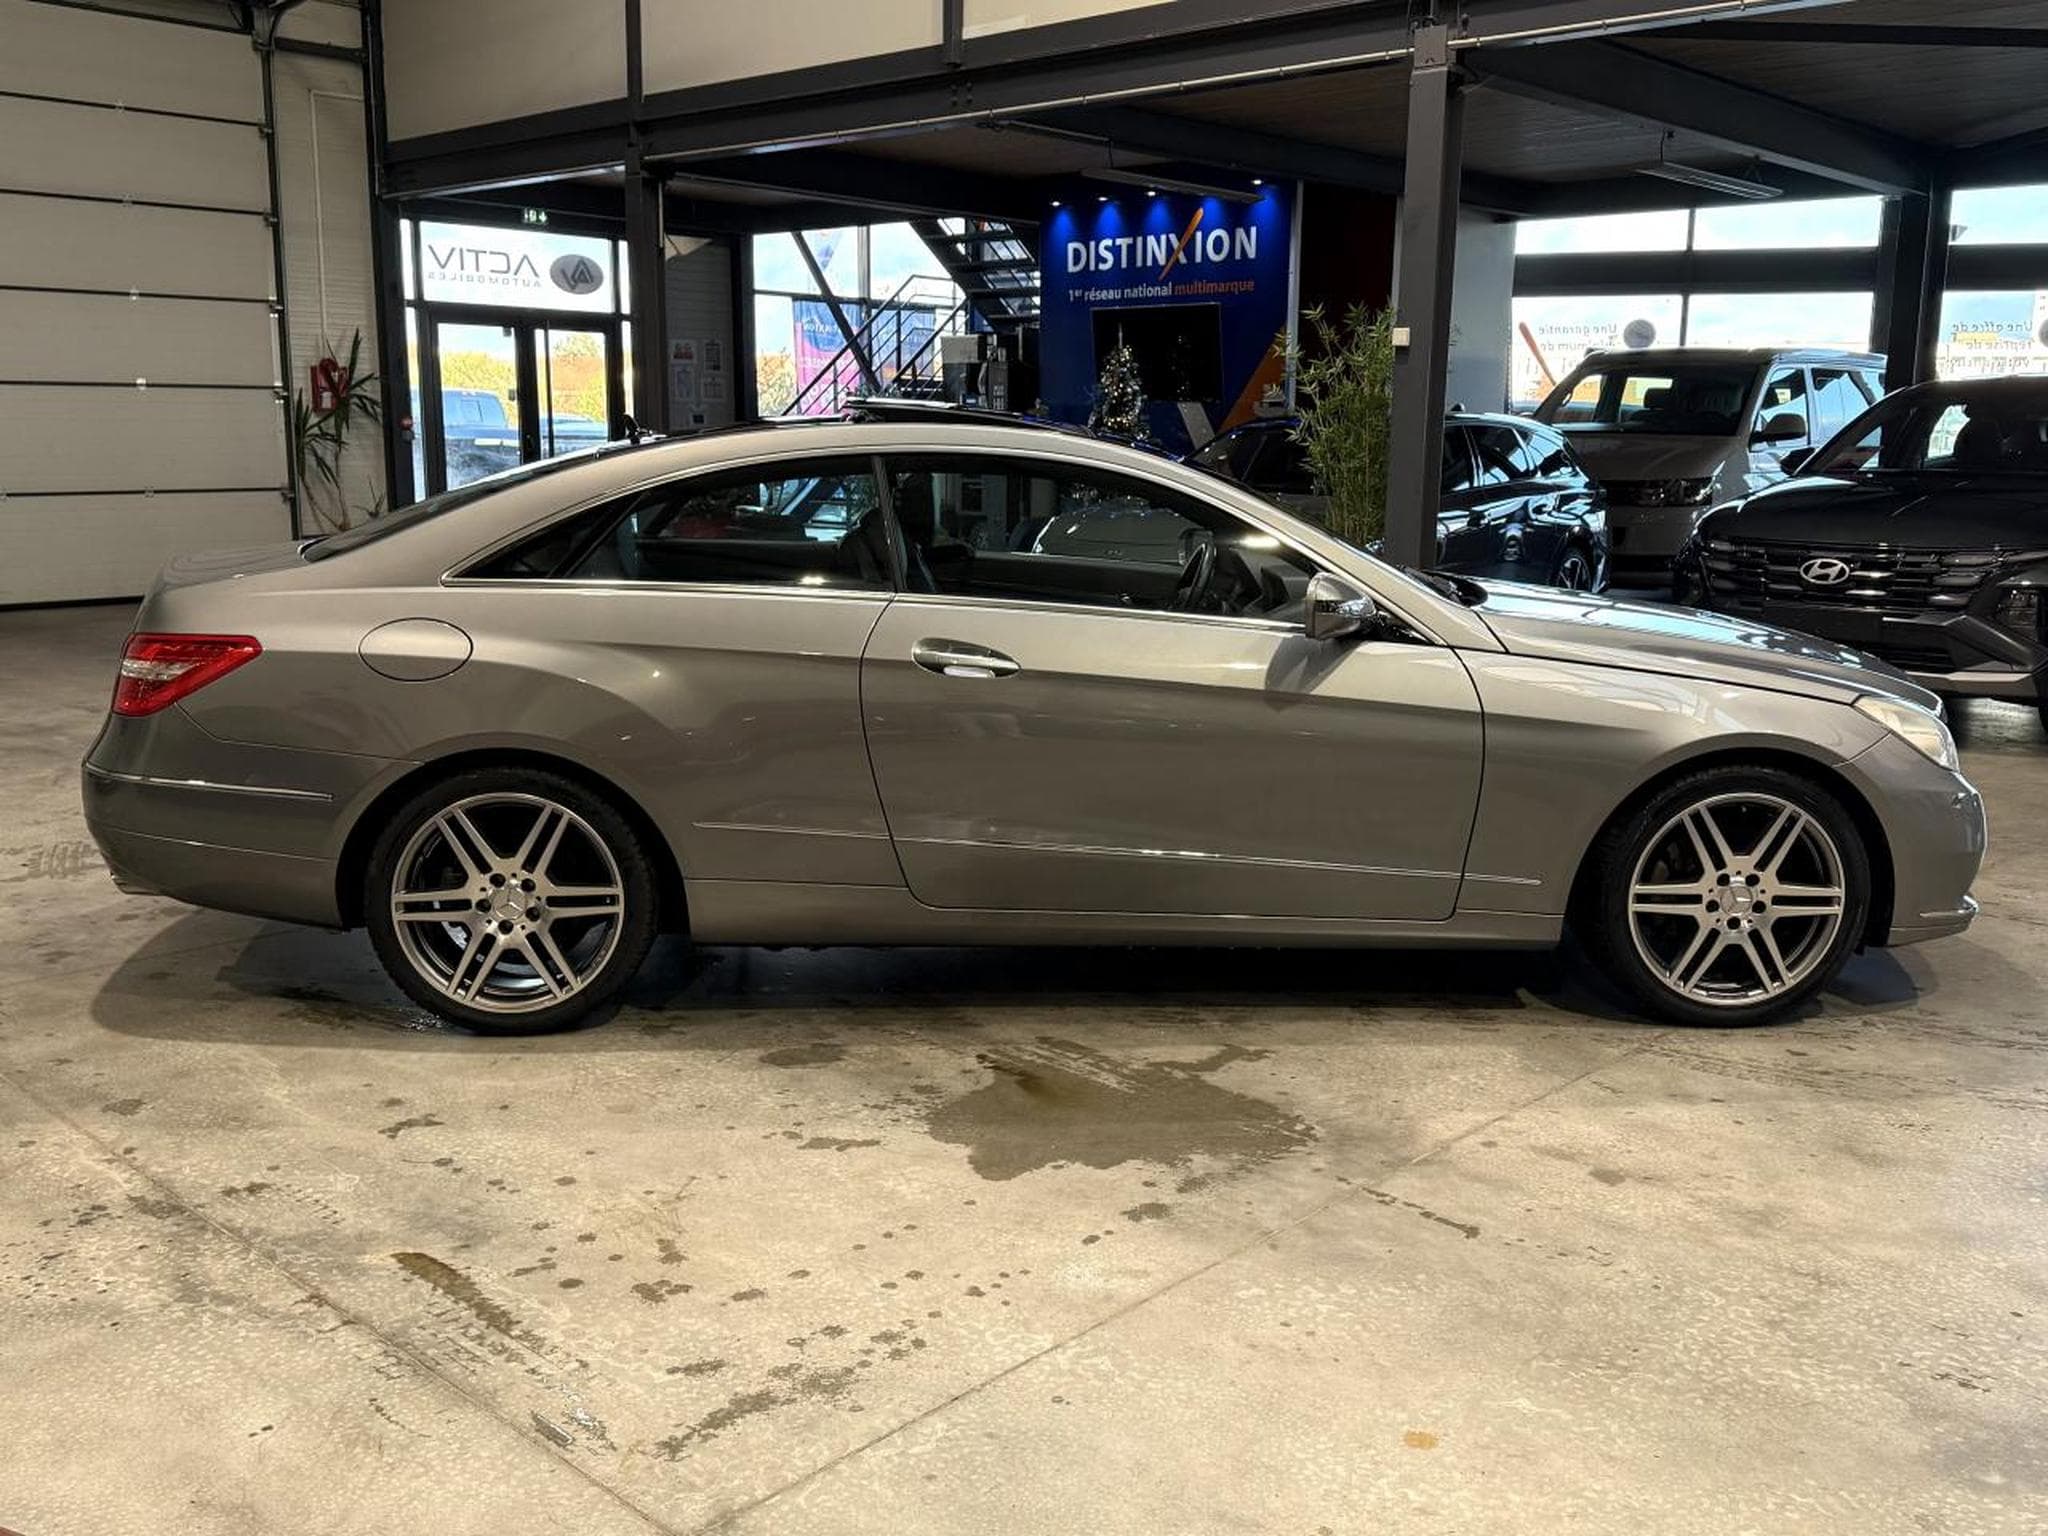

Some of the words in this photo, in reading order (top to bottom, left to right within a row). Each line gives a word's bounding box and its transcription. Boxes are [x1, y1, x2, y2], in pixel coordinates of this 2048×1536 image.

[1067, 208, 1257, 281] DISTINXION
[1084, 287, 1121, 301] réseau
[1123, 281, 1173, 299] national
[1174, 279, 1255, 296] multimarque
